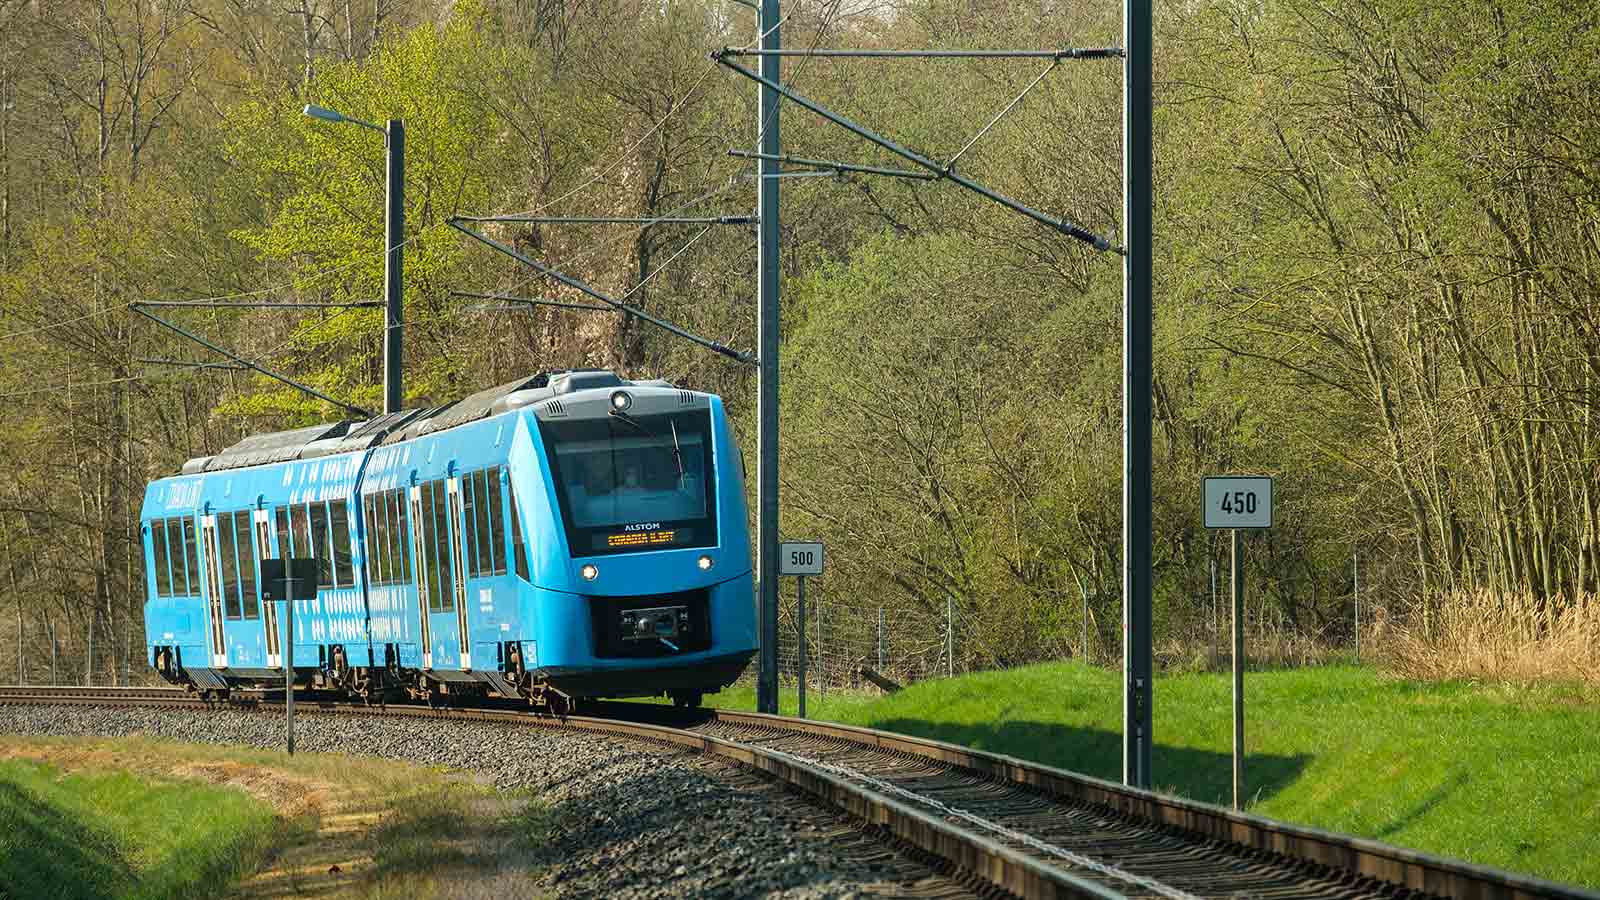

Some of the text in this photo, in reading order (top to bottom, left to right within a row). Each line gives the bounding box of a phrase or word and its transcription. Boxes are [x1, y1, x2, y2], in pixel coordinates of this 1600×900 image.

[1221, 491, 1257, 514] 450
[625, 522, 660, 531] ALSTOM
[791, 551, 814, 565] 500
